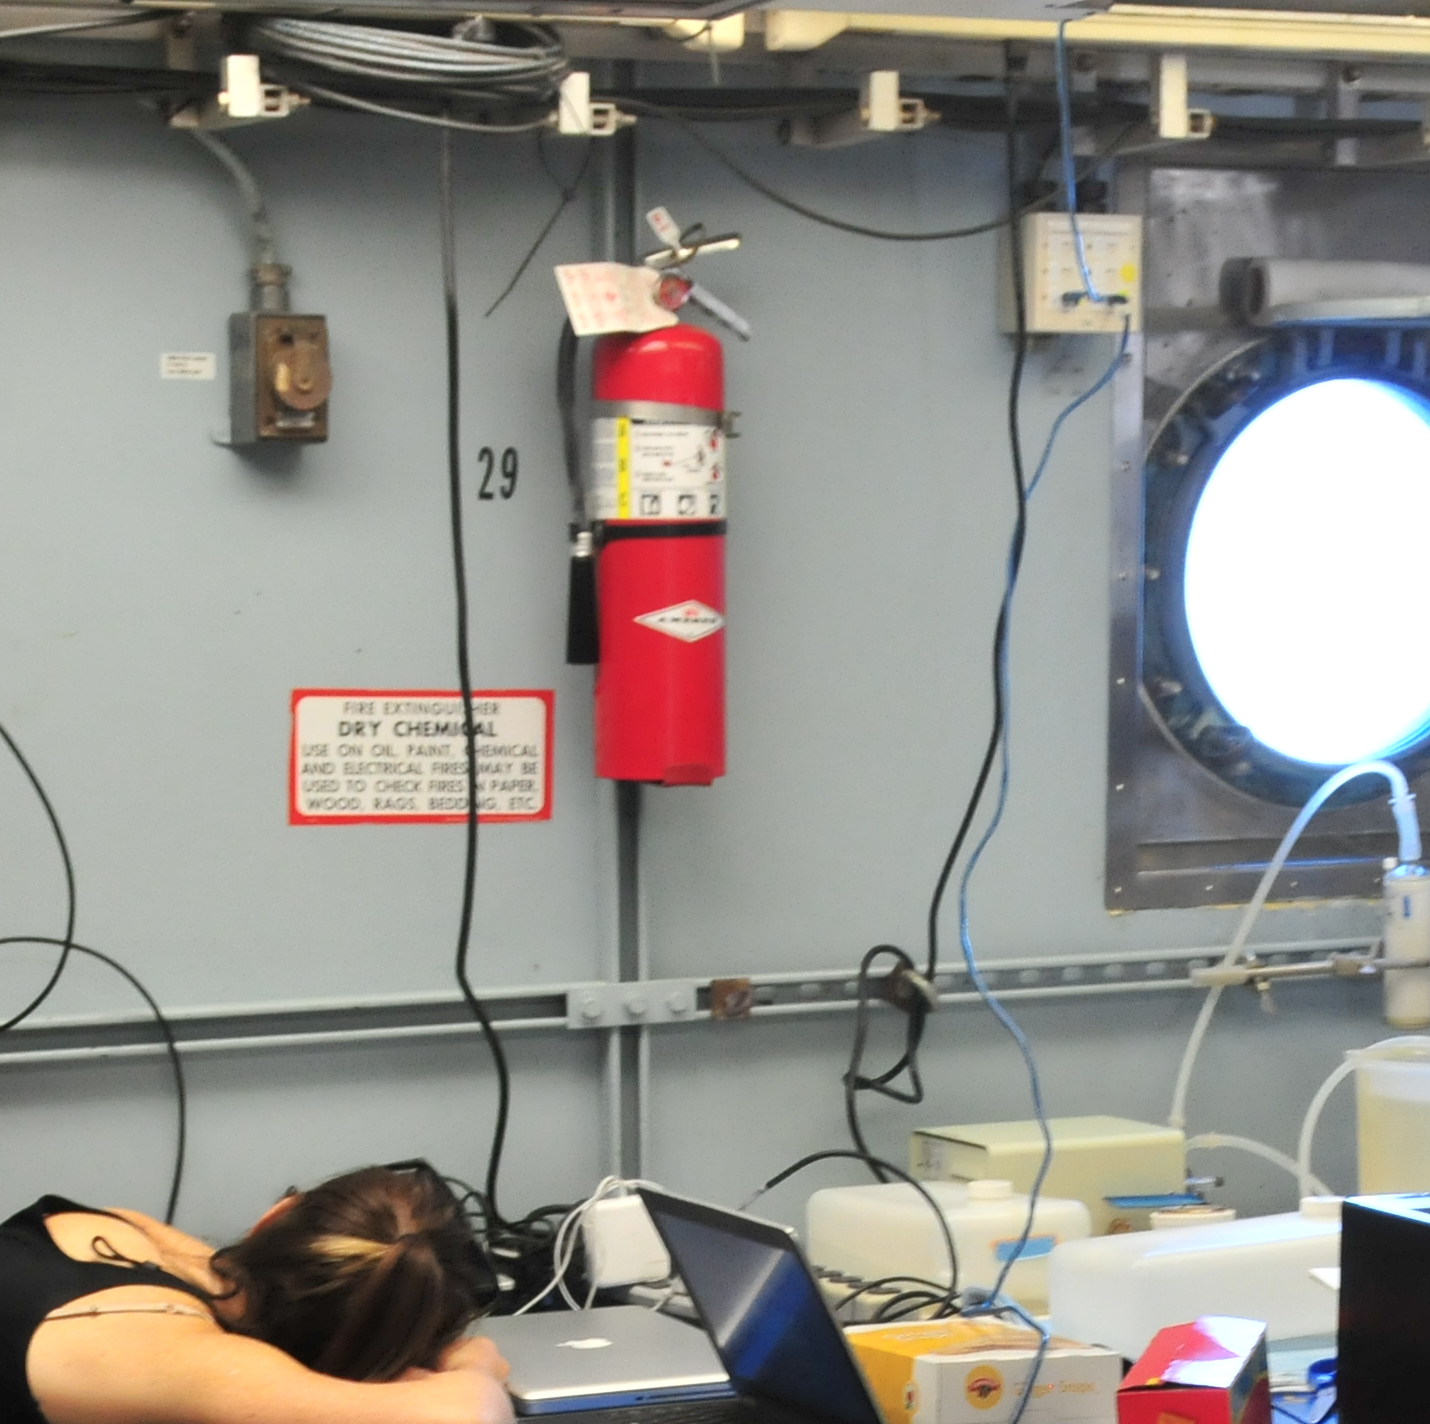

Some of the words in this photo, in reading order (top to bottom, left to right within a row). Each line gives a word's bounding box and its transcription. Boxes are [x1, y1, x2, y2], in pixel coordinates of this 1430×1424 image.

[478, 446, 518, 500] 29
[343, 702, 375, 715] FIRE
[383, 702, 501, 716] EXTINGUIHER
[338, 721, 381, 737] DRY
[302, 744, 328, 757] USE
[338, 744, 363, 757] ON
[301, 762, 335, 775] AND
[343, 762, 424, 775] ELECTRICAL
[521, 762, 539, 775] BE
[303, 780, 340, 793] USED
[345, 780, 367, 793] TO
[375, 780, 422, 793] CHECK
[429, 780, 465, 793] FIRES
